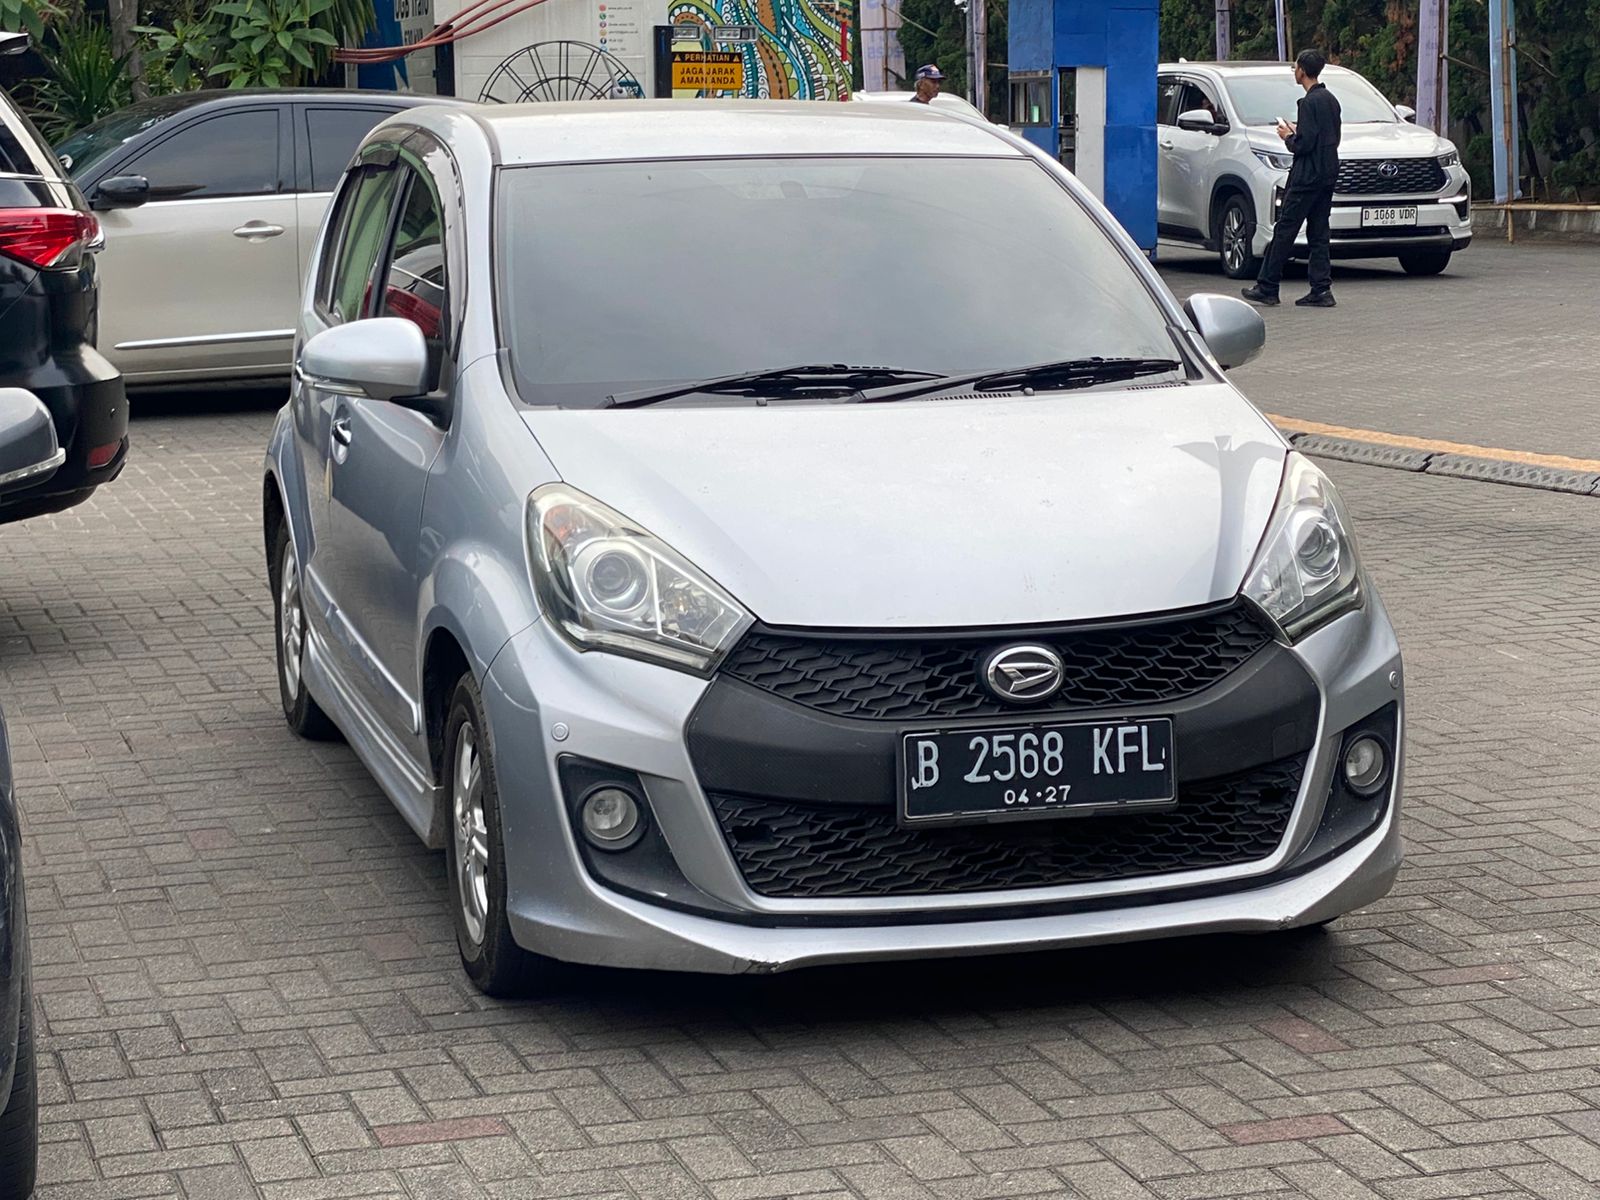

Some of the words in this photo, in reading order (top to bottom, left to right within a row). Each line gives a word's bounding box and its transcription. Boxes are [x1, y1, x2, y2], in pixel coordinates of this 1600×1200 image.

[684, 53, 730, 62] PERHATIAN
[680, 67, 704, 75] JAGA
[706, 67, 736, 75] JARAK
[680, 76, 708, 85] AMAN
[710, 76, 736, 85] ANDA
[1364, 210, 1370, 220] D
[1374, 209, 1396, 220] 1068
[1399, 208, 1416, 220] VDR
[912, 740, 939, 790] B
[963, 731, 1065, 783] 2568
[1092, 725, 1165, 776] KFL
